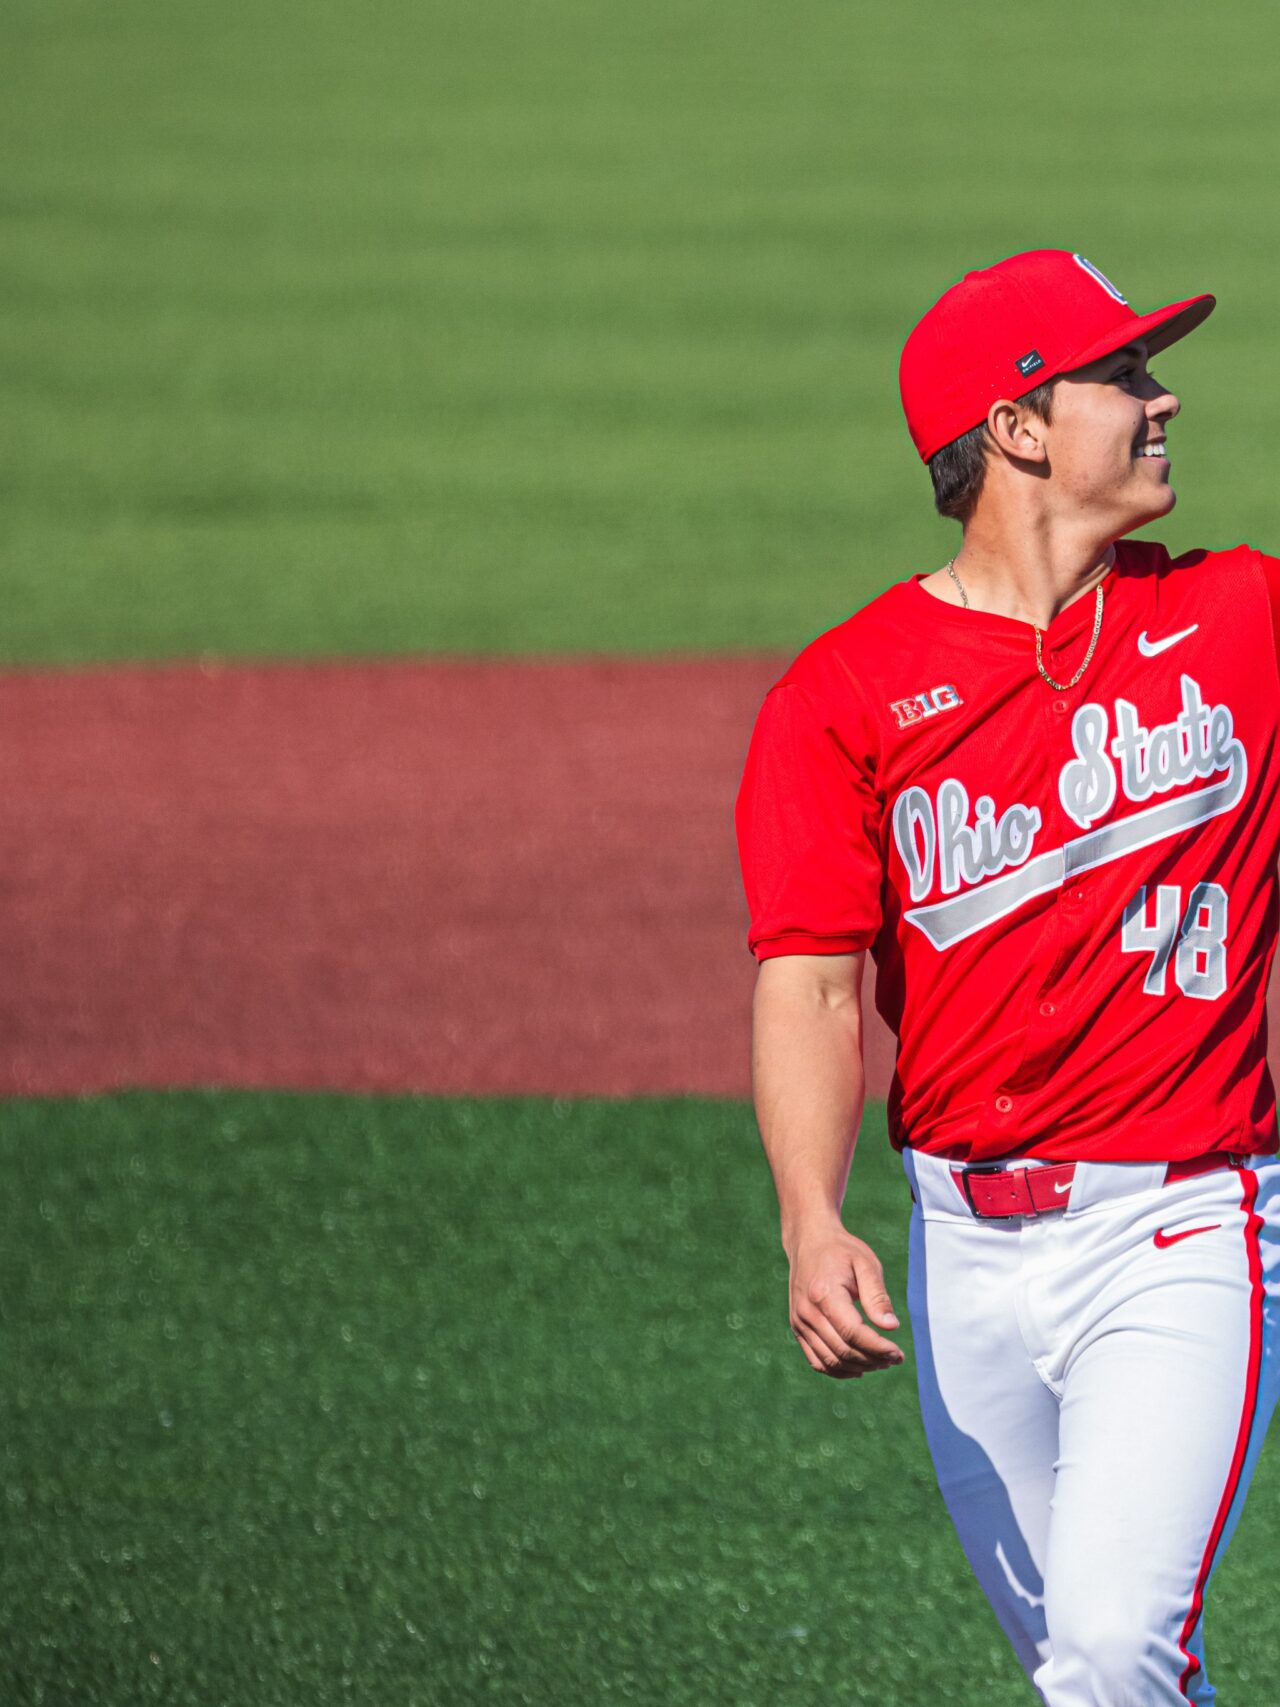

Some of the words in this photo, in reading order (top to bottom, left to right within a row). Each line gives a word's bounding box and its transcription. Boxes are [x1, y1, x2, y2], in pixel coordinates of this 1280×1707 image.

[893, 778, 1042, 901] Ohio
[1058, 673, 1244, 829] State
[1121, 881, 1230, 1001] 48
